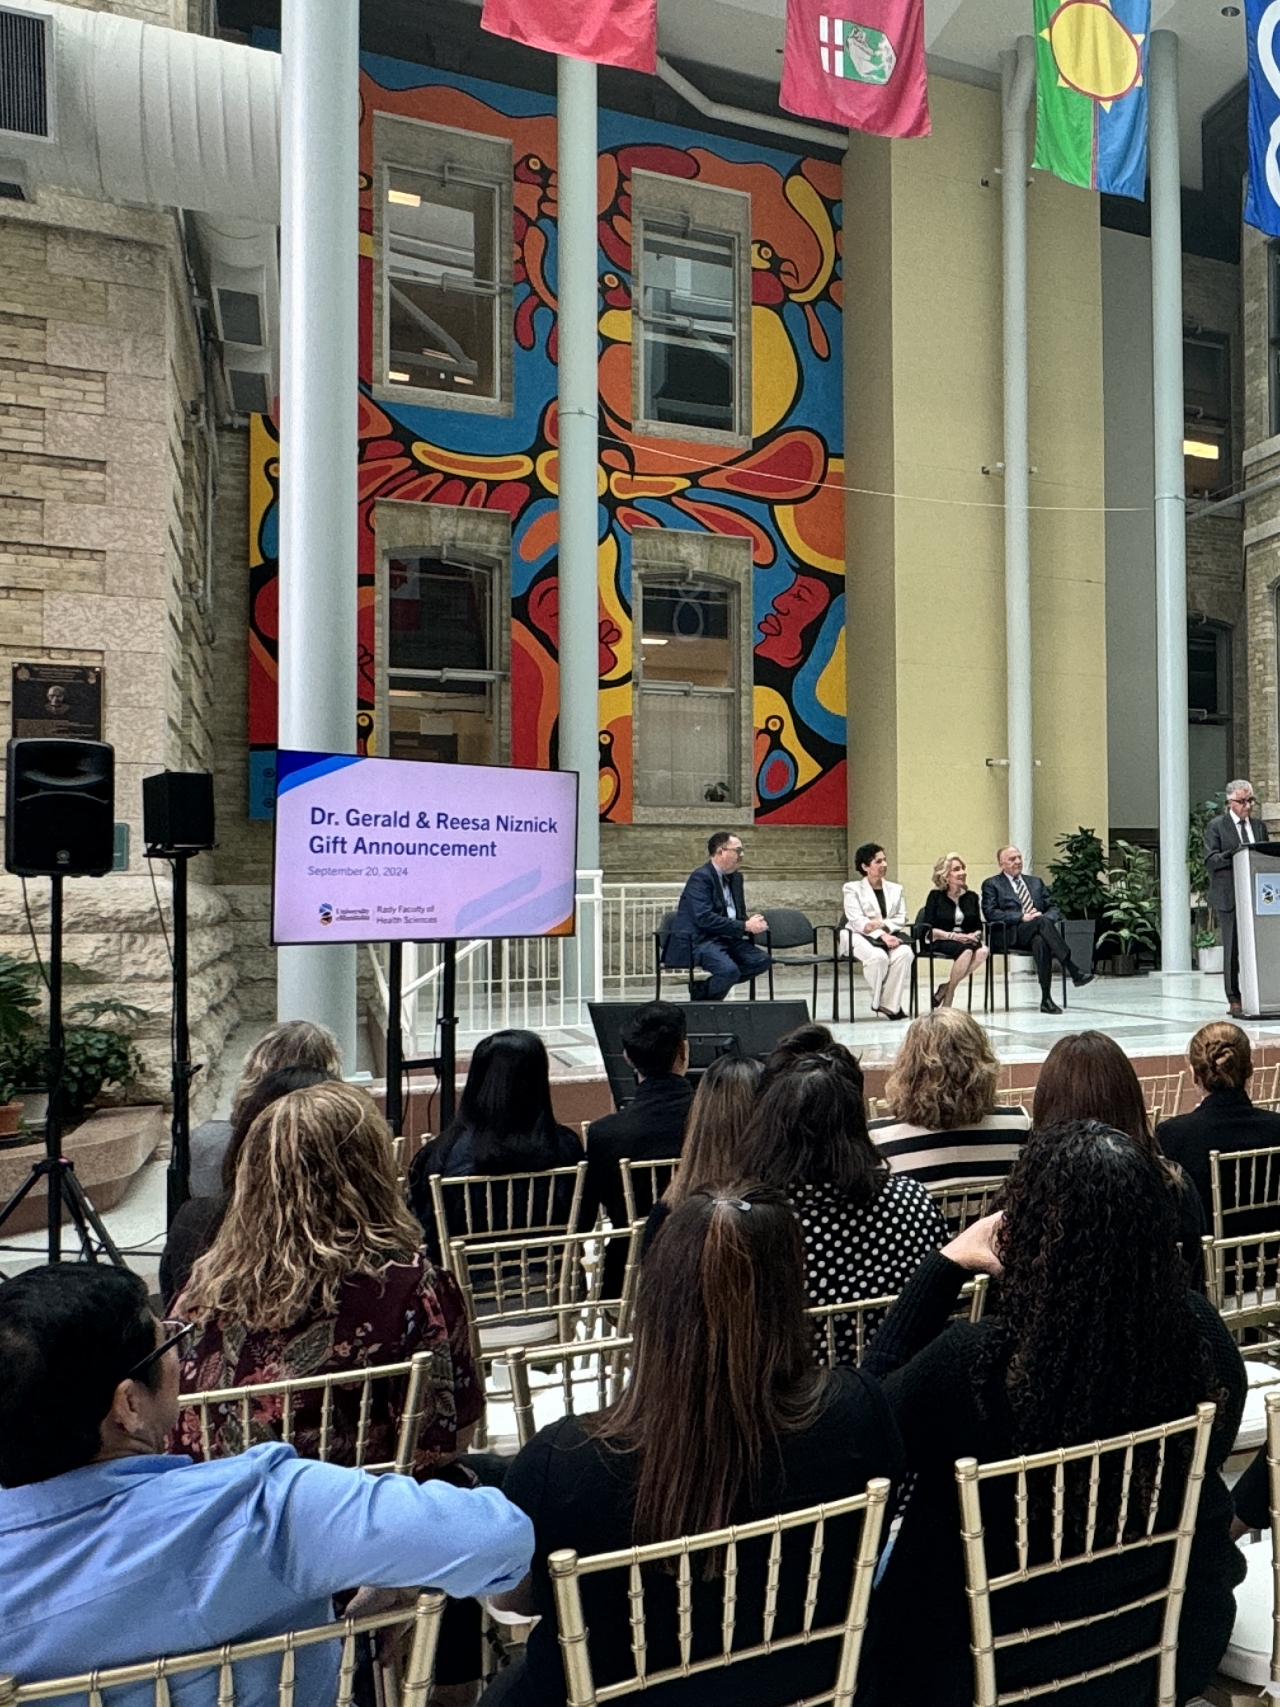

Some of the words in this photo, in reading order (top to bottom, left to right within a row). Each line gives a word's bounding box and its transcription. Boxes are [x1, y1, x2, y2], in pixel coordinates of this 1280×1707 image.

[310, 807, 339, 826] Dr.
[345, 808, 410, 829] Gerald
[416, 812, 431, 829] &
[436, 812, 490, 831] Reesa
[496, 815, 558, 834] Niznick
[309, 835, 347, 854] Gift
[353, 836, 497, 857] Announcement
[307, 866, 363, 877] September
[365, 866, 380, 877] 20,
[383, 867, 408, 876] 2024
[398, 905, 425, 914] Faculty
[426, 905, 435, 913] of
[376, 916, 402, 924] Health
